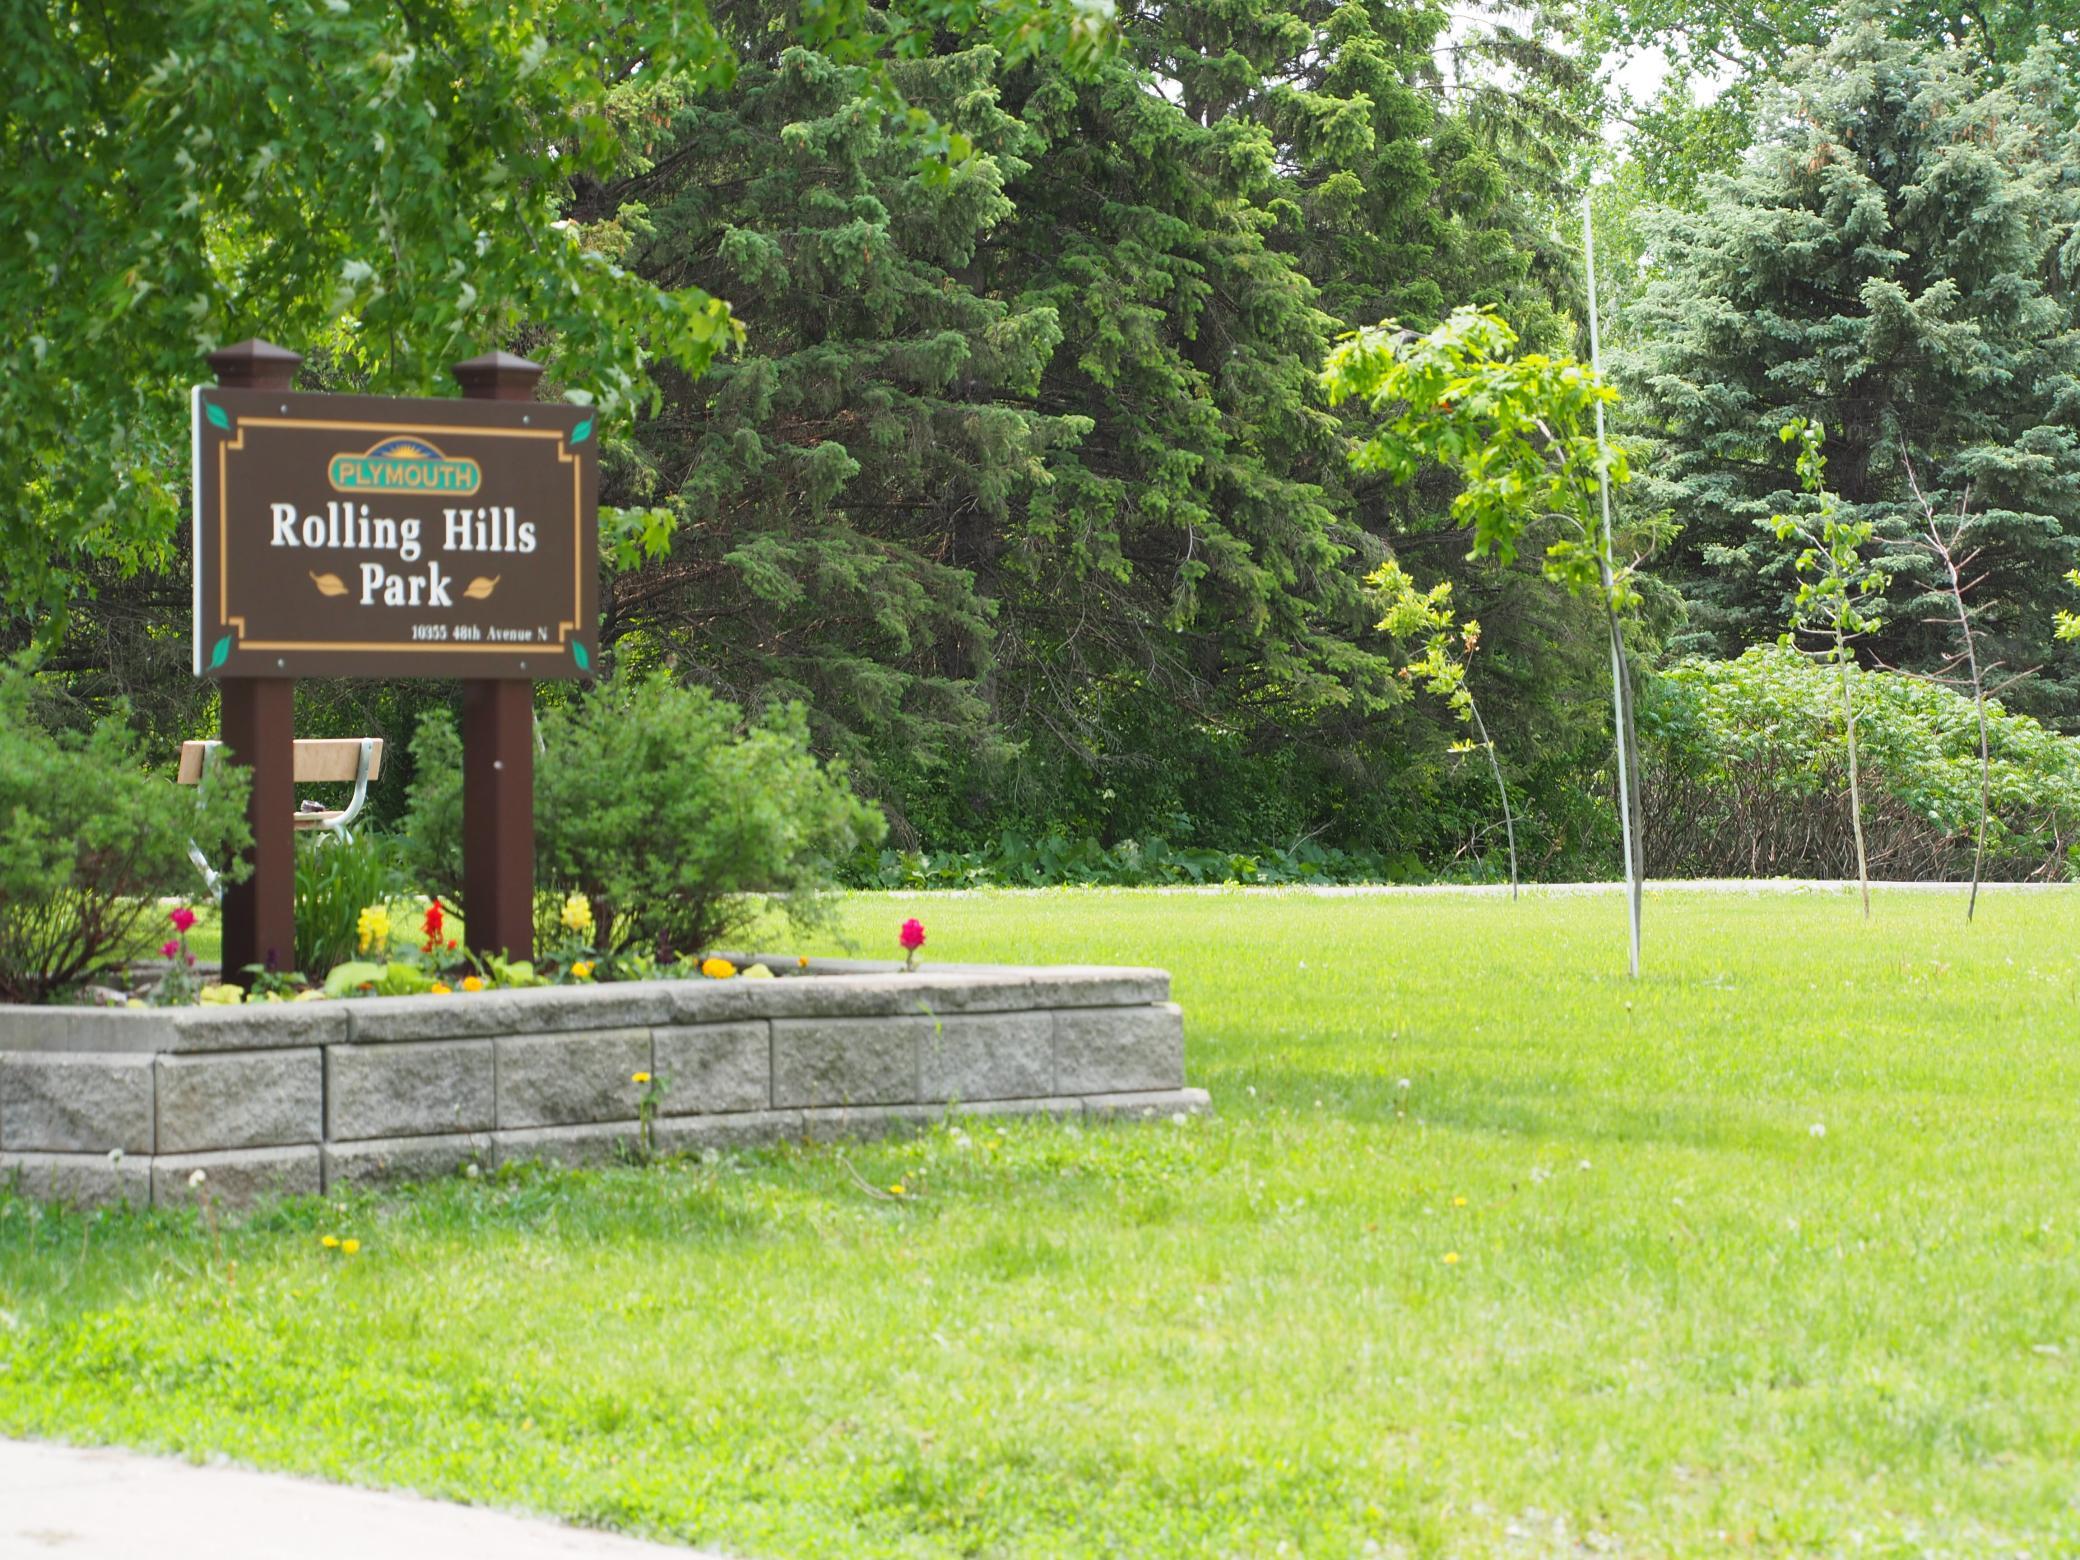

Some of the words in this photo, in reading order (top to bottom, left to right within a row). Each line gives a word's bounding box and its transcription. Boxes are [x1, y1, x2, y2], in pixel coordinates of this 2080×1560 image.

[338, 462, 472, 488] PLYMOUTH
[270, 501, 422, 562] Rolling
[442, 506, 537, 553] Hills
[359, 561, 453, 607] Park
[452, 624, 481, 641] 48th
[486, 625, 532, 641] Avenue
[537, 626, 548, 641] N
